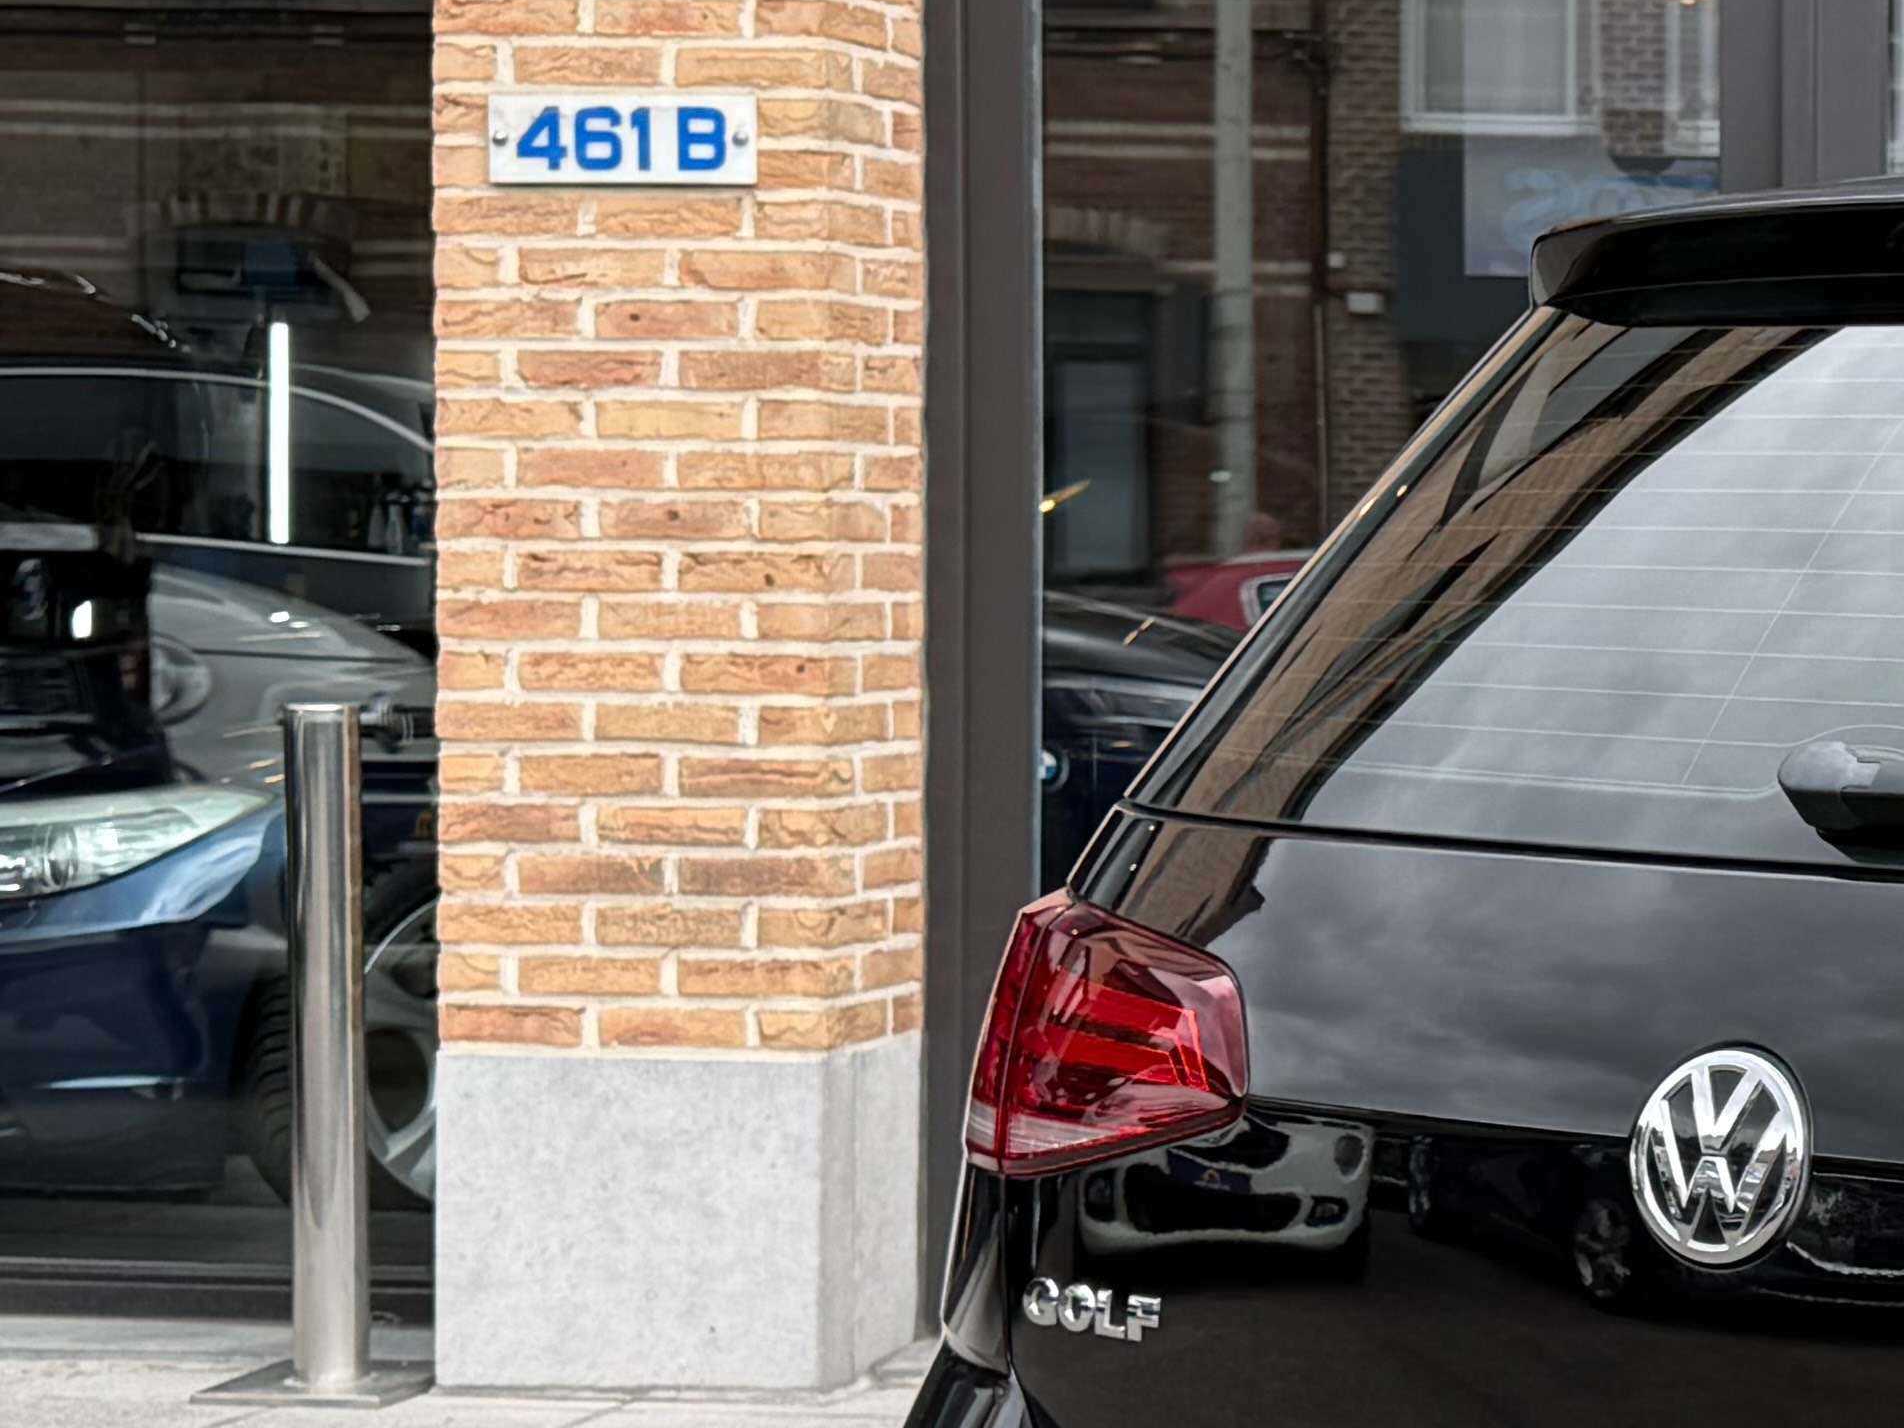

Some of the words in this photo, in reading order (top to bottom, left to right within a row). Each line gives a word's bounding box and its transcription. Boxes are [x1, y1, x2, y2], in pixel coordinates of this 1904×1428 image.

[516, 106, 652, 172] 461
[676, 106, 728, 173] B
[1022, 1276, 1162, 1342] GOLF
